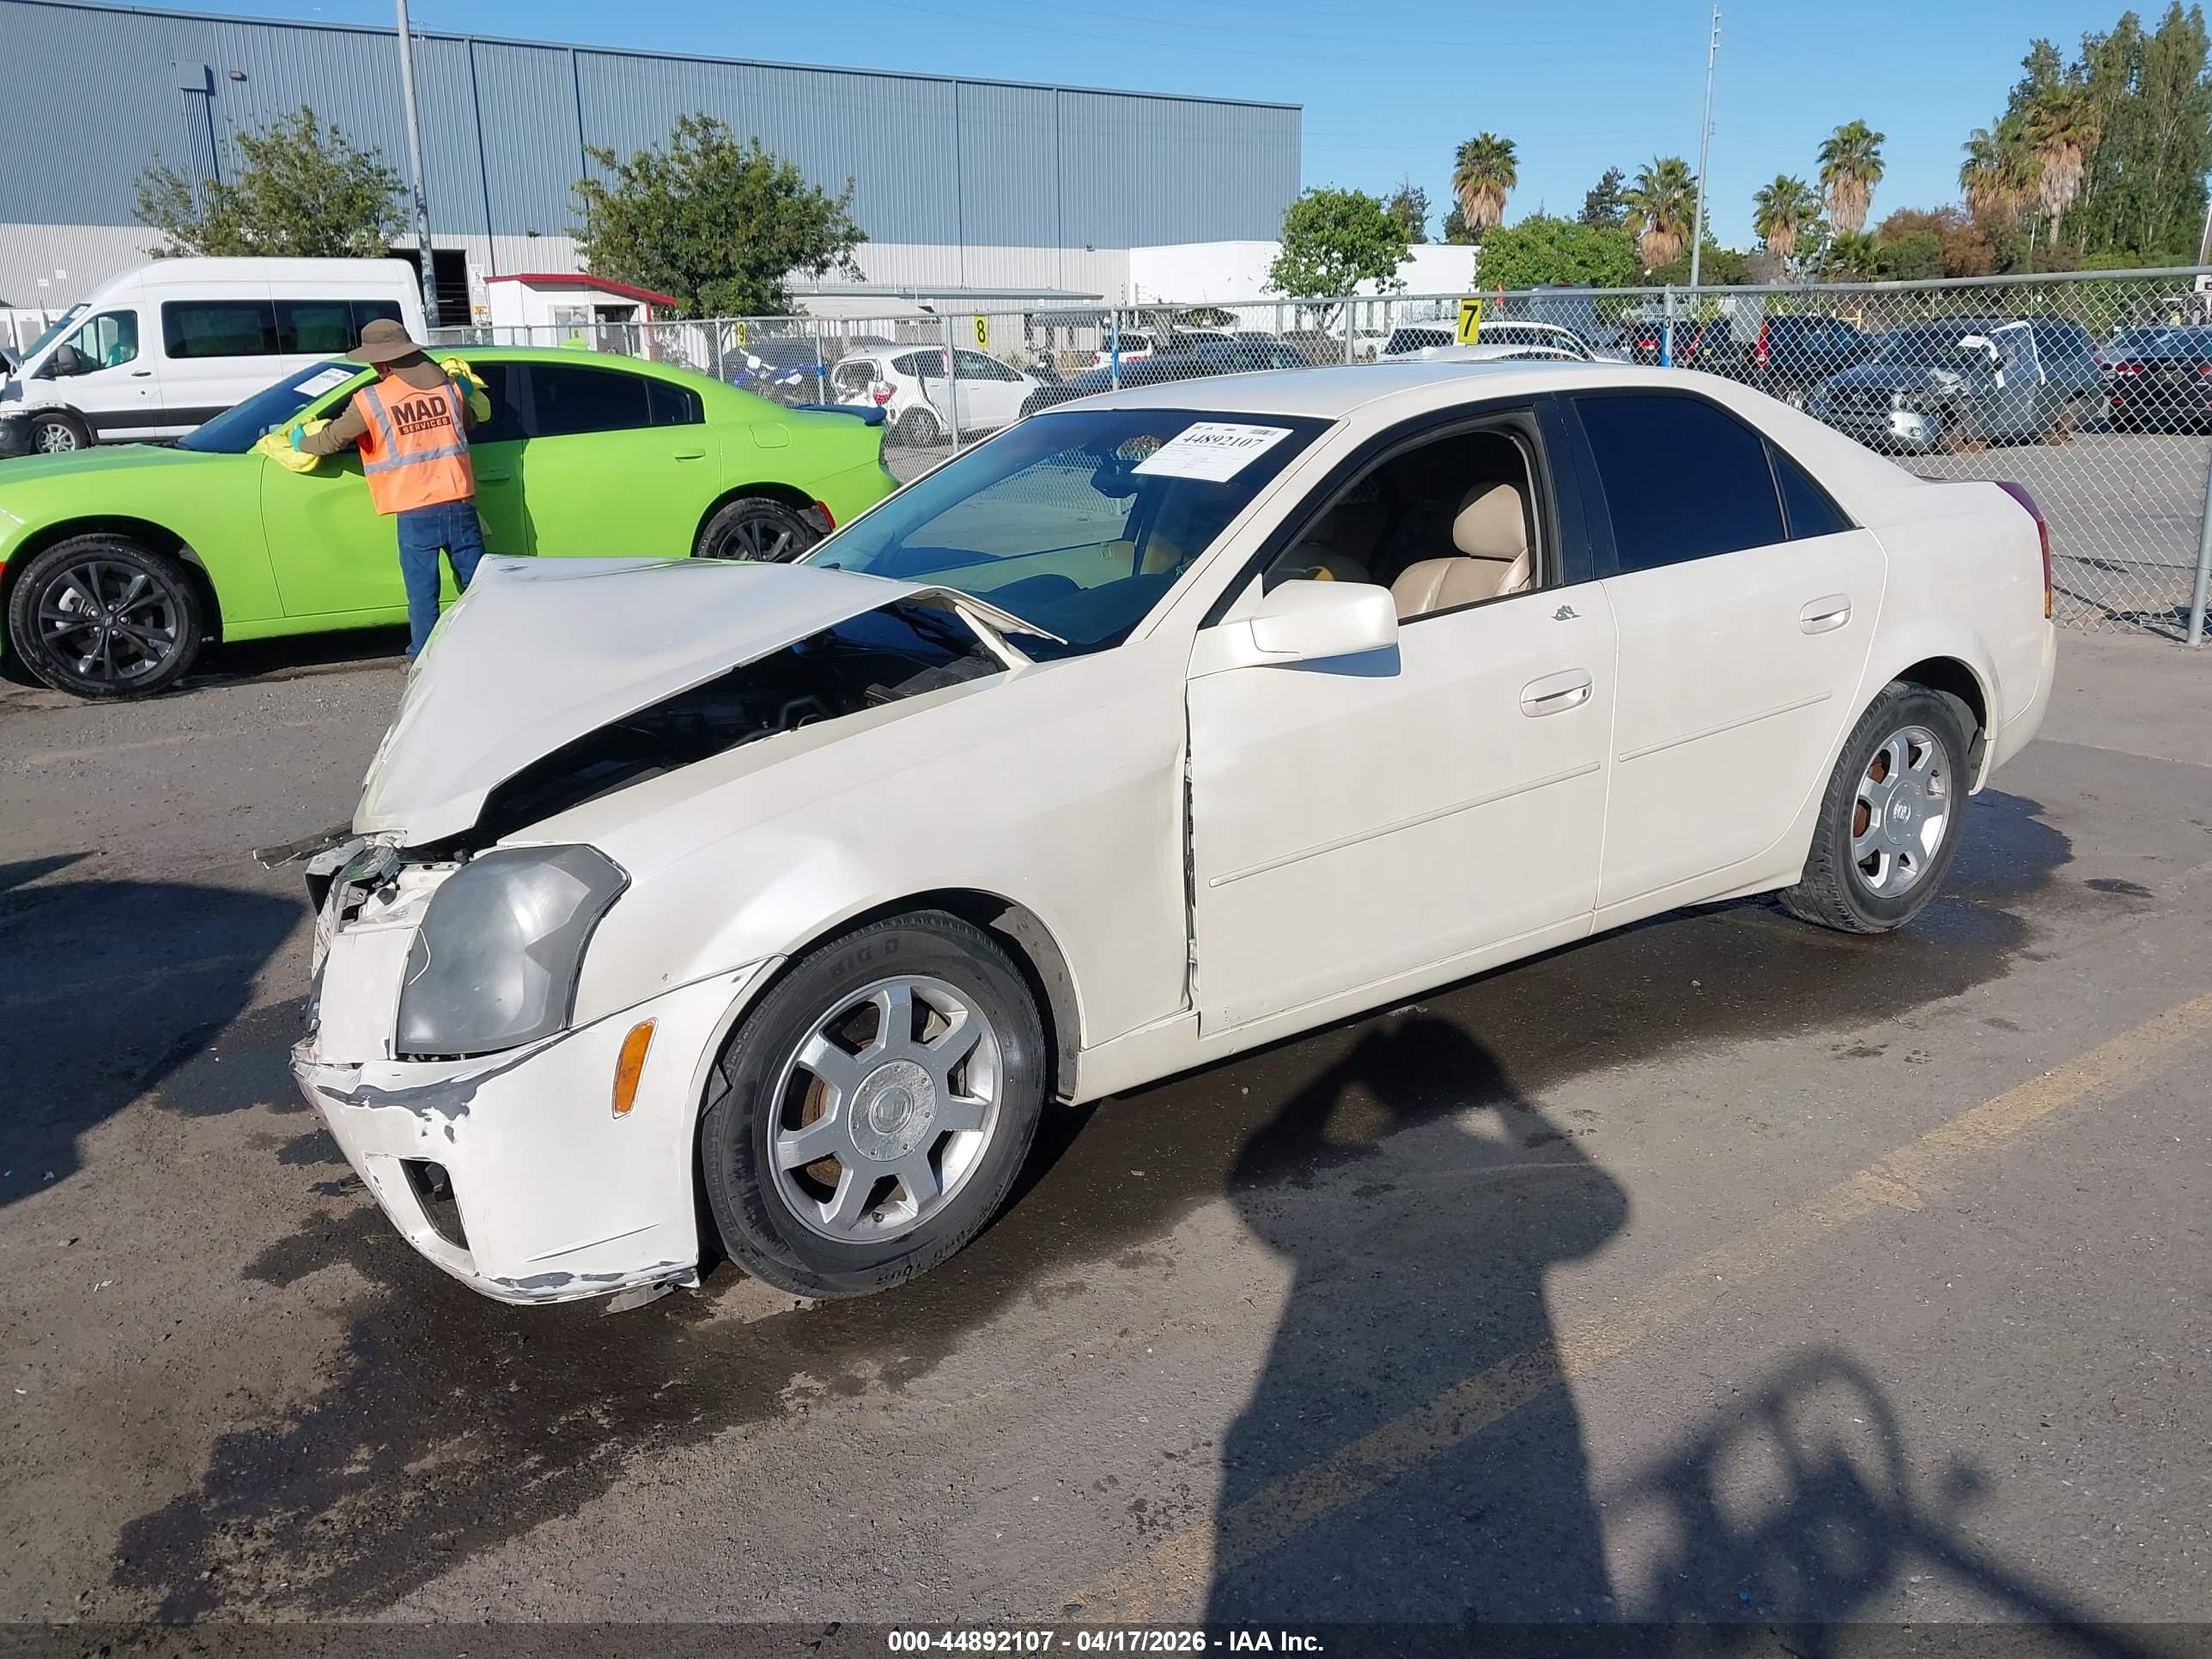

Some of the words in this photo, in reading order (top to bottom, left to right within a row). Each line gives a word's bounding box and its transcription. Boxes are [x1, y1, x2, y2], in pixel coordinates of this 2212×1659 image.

[1462, 304, 1479, 337] 7
[1663, 315, 1672, 330] 3
[738, 323, 744, 343] 9
[976, 319, 986, 343] 8
[390, 396, 447, 426] MAD
[402, 417, 448, 434] SERVICES
[1182, 433, 1267, 449] 44892107
